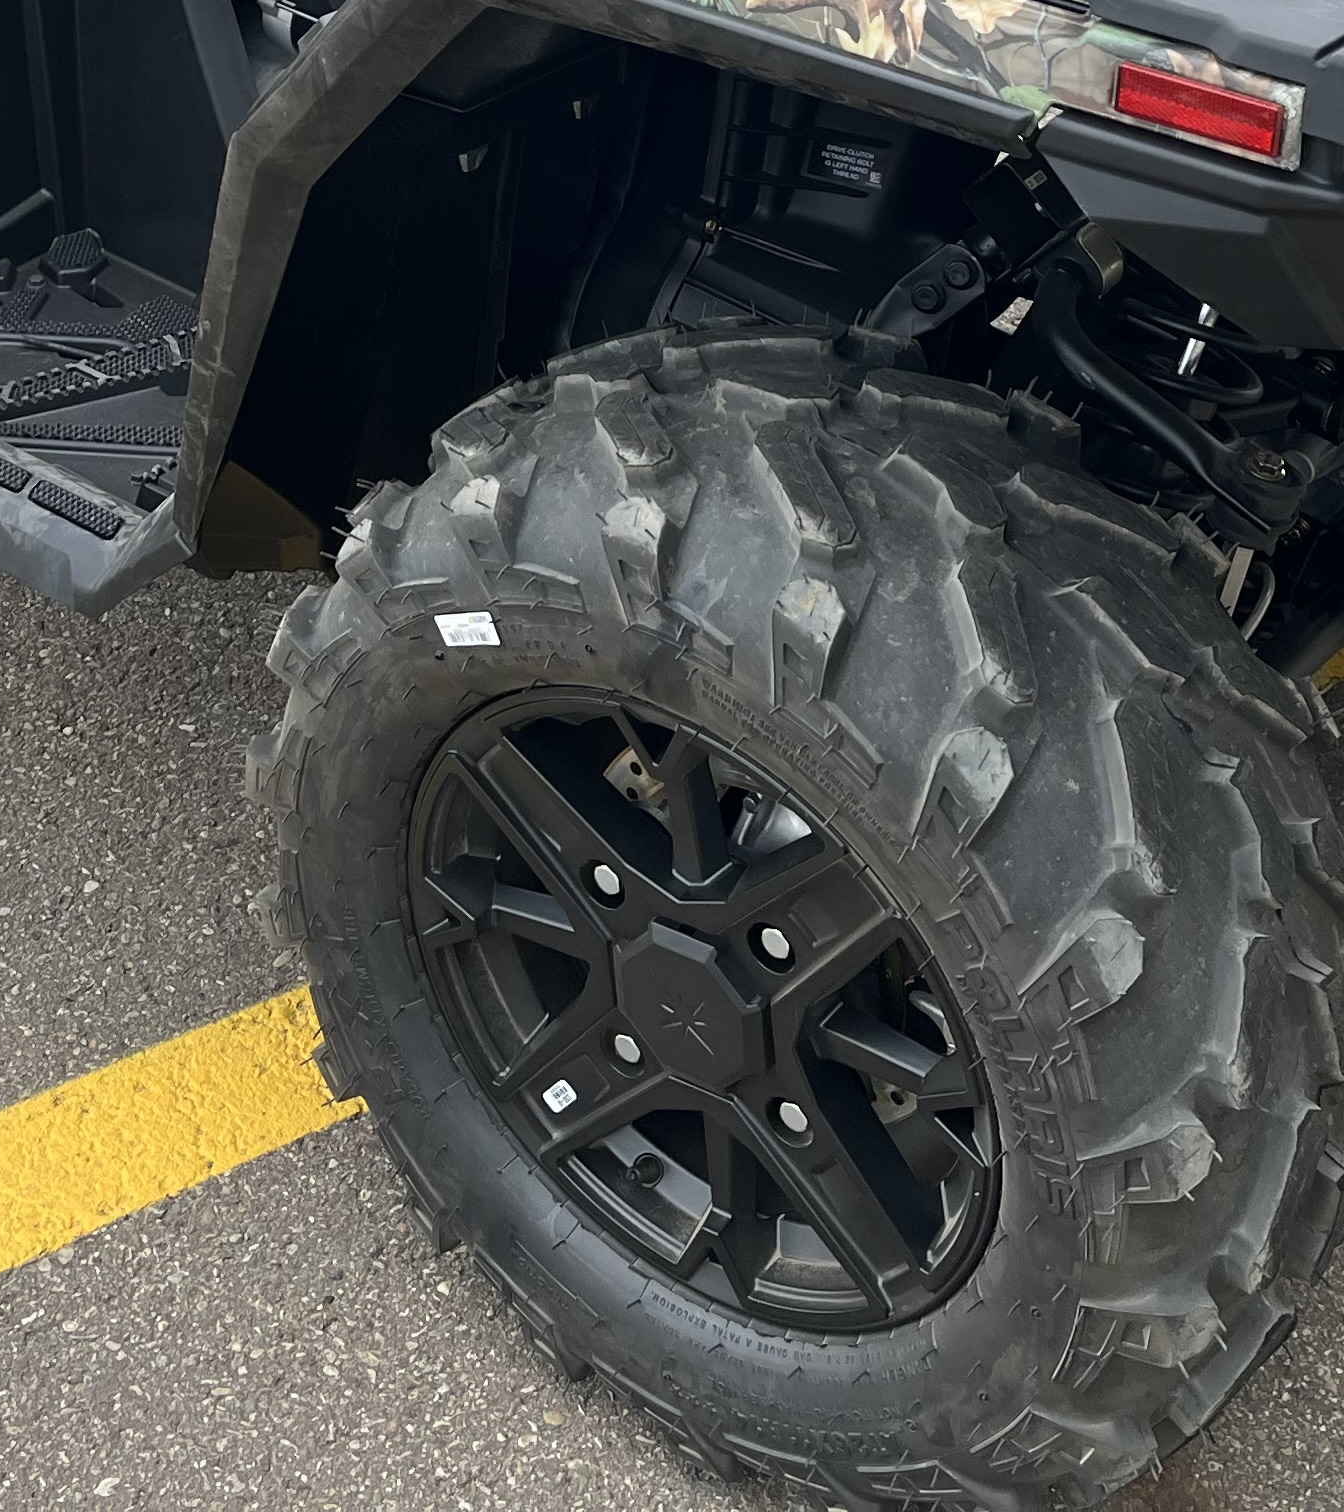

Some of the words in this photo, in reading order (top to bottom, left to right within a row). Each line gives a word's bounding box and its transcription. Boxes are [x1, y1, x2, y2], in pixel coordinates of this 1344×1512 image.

[847, 149, 875, 159] CLUTCH
[832, 161, 849, 170] LEFT
[849, 165, 869, 174] HAND
[938, 915, 1064, 1217] POLARIS
